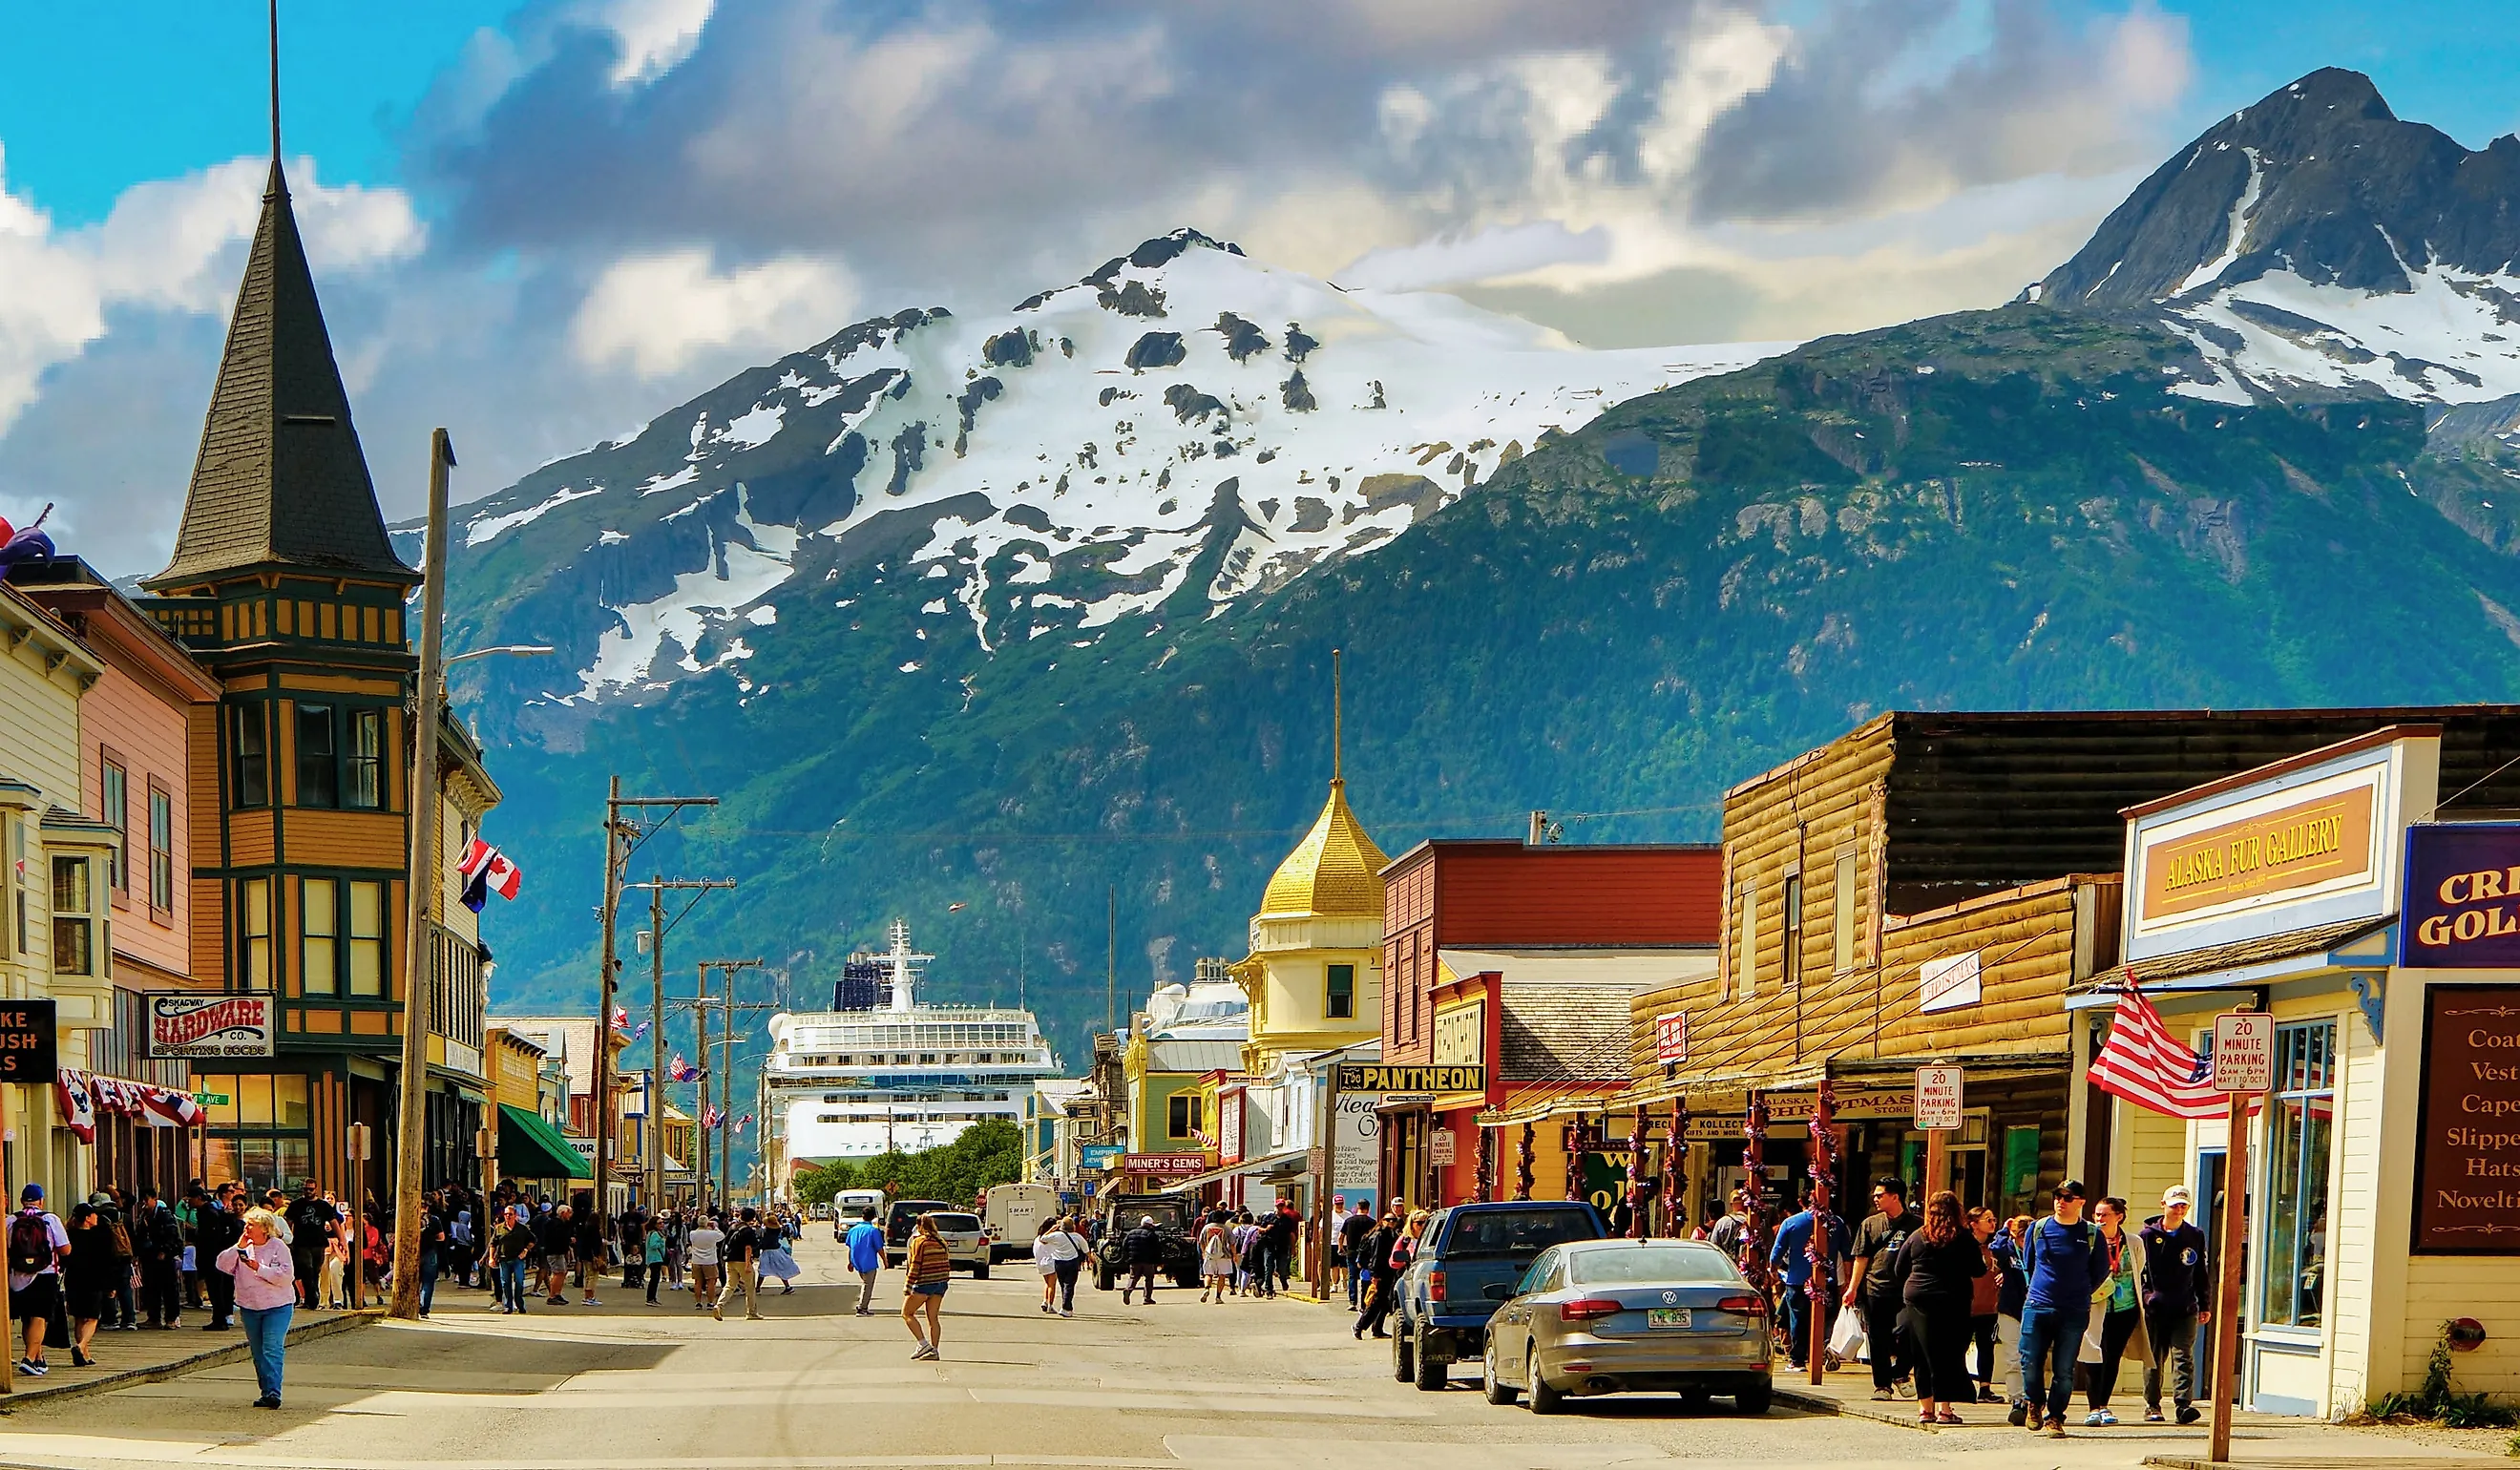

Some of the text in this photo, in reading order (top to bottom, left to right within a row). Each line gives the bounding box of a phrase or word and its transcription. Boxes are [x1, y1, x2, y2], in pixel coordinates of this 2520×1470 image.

[2165, 813, 2343, 891] ALASKA FUR GALLERY
[2418, 907, 2520, 945] GOL
[168, 998, 204, 1007] SKAGWAY
[154, 999, 264, 1044] HARDWARE
[2236, 1022, 2253, 1036] 20
[230, 1032, 247, 1040] CO.
[152, 1044, 266, 1055] SPORTING GOODS
[2224, 1039, 2261, 1050] MINUTE
[2219, 1054, 2265, 1065] PARKING
[1363, 1067, 1480, 1090] PANTHEON
[1932, 1073, 1946, 1084] 20
[1923, 1086, 1953, 1096] MINUTE
[1335, 1092, 1380, 1113] Hea
[1767, 1094, 1915, 1118] CHRSTMAS
[1921, 1098, 1956, 1108] PARKING
[1874, 1105, 1910, 1115] STORE
[1127, 1158, 1202, 1169] MINER'S GEMS
[1671, 1312, 1688, 1323] 835
